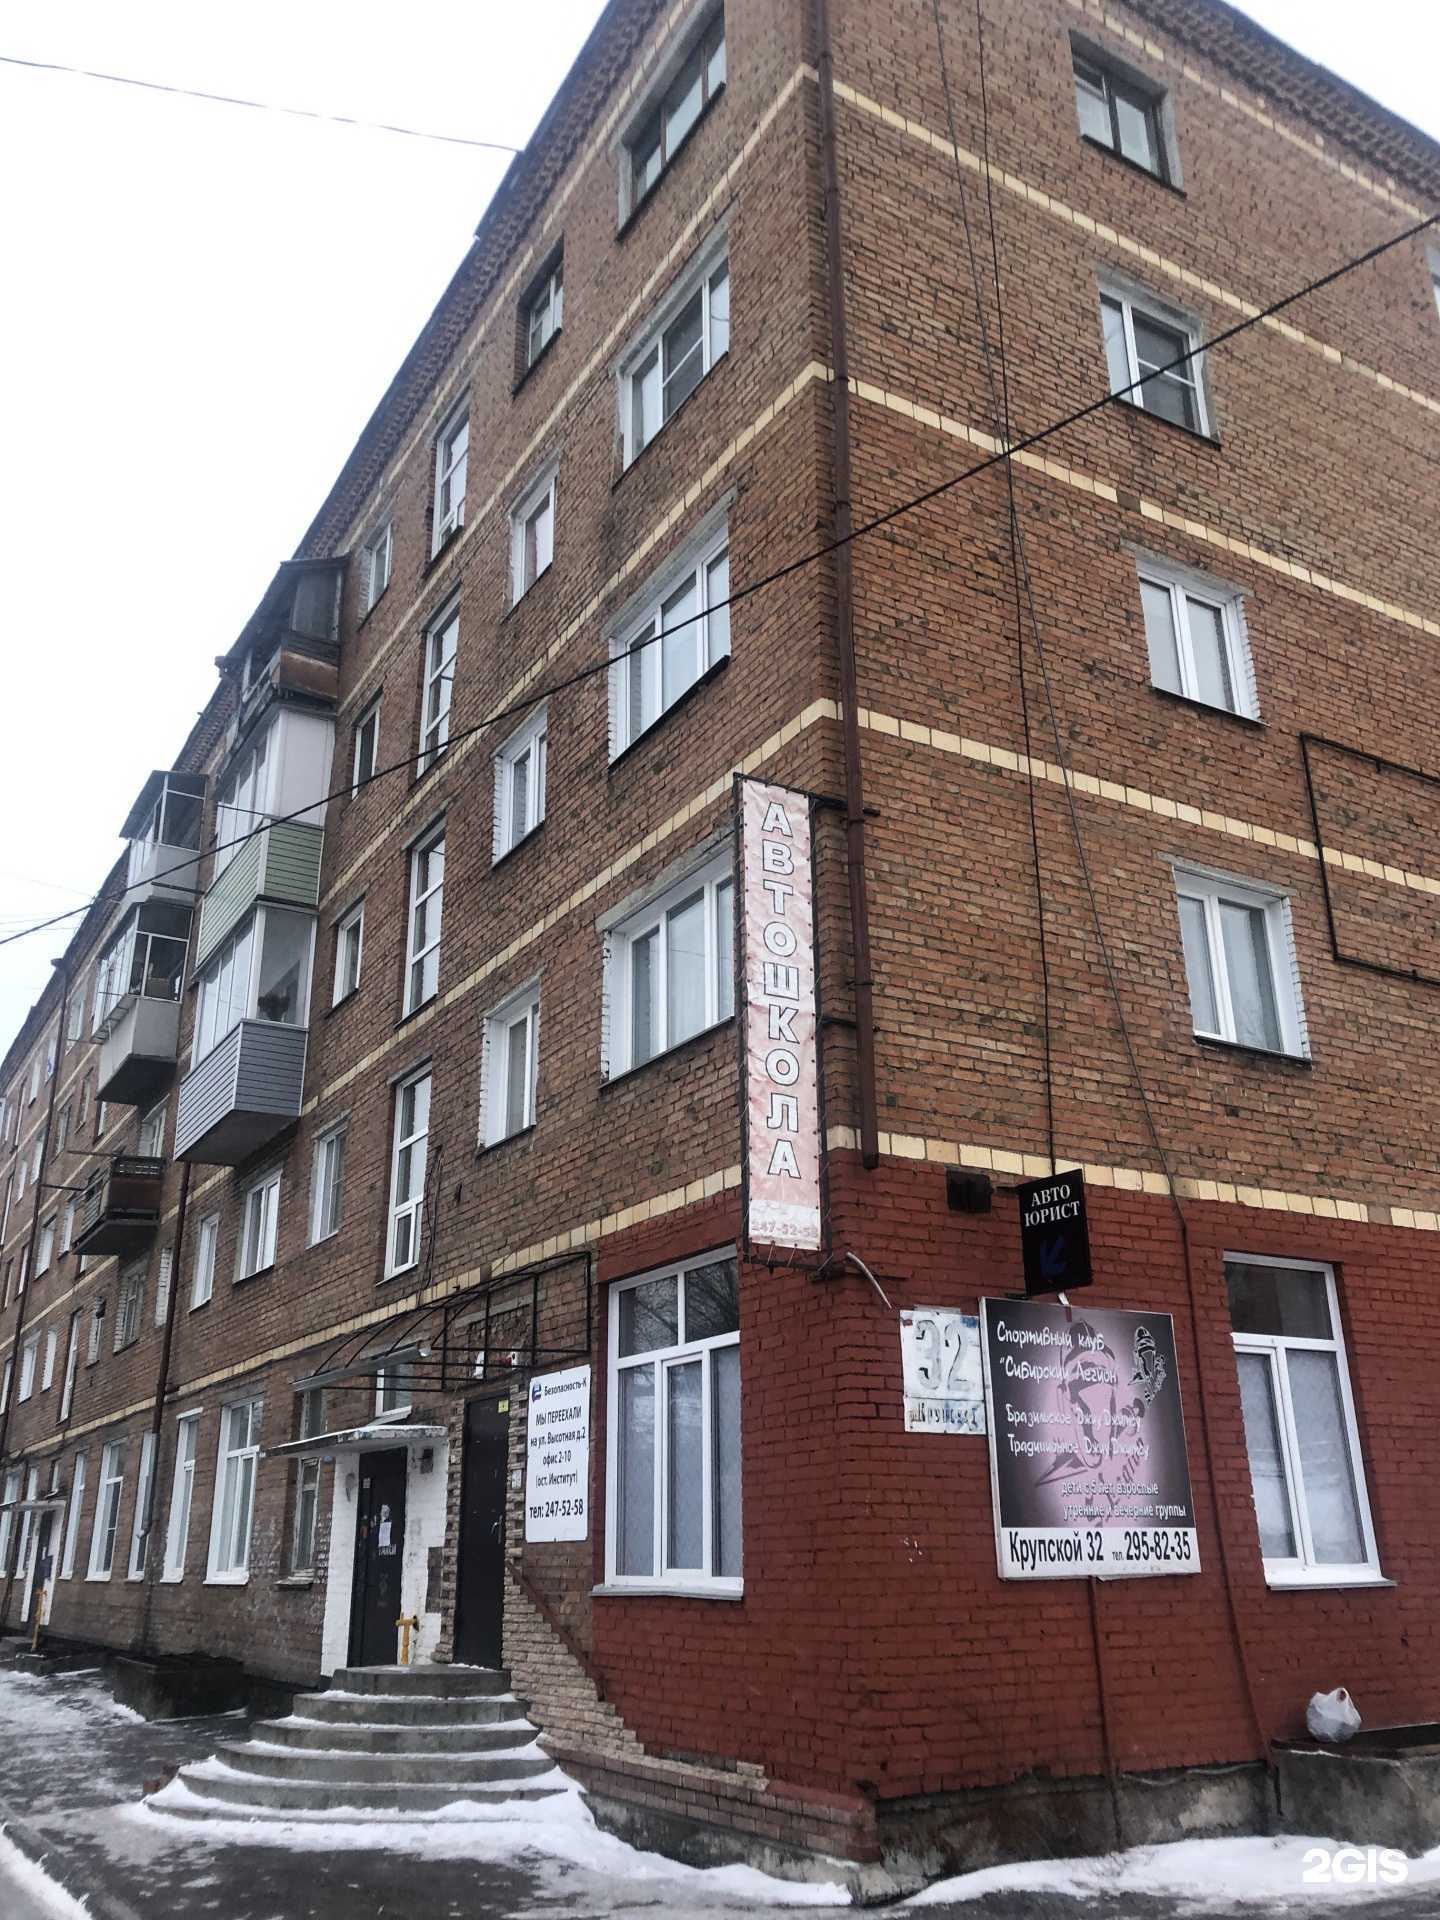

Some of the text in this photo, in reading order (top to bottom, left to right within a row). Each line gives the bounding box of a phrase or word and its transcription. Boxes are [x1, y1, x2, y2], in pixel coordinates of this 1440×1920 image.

[762, 801, 801, 1180] АВТОШКОЛА
[1031, 1184, 1071, 1207] АВТО
[1024, 1200, 1081, 1227] ЮРИСТ
[997, 1320, 1105, 1351] Спортивный клуб
[915, 1319, 976, 1392] 32
[544, 1377, 587, 1396] Безопасность-К
[547, 1406, 582, 1424] ПЕРЕЕХАЛИ
[530, 1438, 538, 1447] на
[538, 1436, 546, 1449] ул.
[547, 1431, 575, 1445] Высотная
[542, 1449, 572, 1468] офис 2-10
[548, 1469, 578, 1487] Институт)
[529, 1498, 584, 1519] тел: 247-52-58
[1063, 1504, 1105, 1521] утренние
[1114, 1504, 1154, 1518] вечерние
[1155, 1504, 1187, 1521] группы
[1010, 1530, 1191, 1571] Крупской 32 тел. 295-82-35
